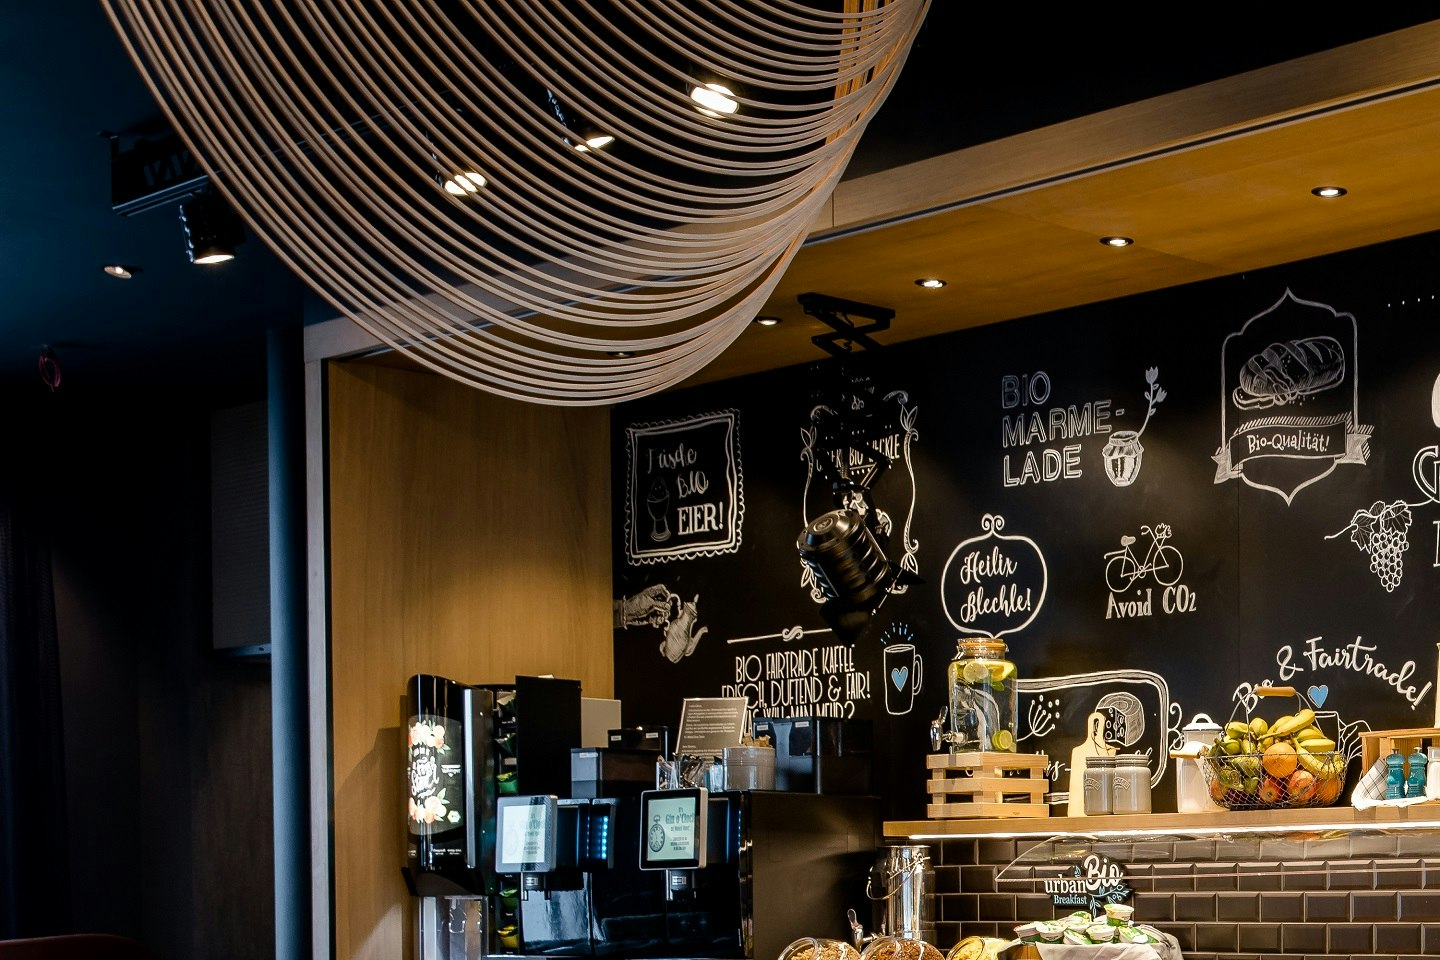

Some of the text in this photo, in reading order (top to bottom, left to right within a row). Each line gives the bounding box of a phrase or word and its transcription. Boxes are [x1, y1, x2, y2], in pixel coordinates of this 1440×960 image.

[1001, 370, 1052, 409] BIO
[1002, 399, 1126, 449] MARME-
[1247, 429, 1330, 453] Bio-Qualität!
[1003, 444, 1083, 488] LADE
[677, 501, 724, 536] EIER!
[960, 546, 1018, 585] Heilix
[960, 586, 1032, 623] Blechle!
[1106, 588, 1152, 619] Avoid
[735, 654, 762, 682] BIO
[766, 648, 819, 680] FAIRTRADE
[1277, 645, 1304, 681] &
[1303, 635, 1433, 711] Fairtrade!
[770, 676, 823, 707] DUFTEND
[827, 675, 841, 702] &
[846, 670, 871, 700] FAIR!
[1045, 854, 1124, 894] urban Bio
[1053, 894, 1088, 905] Breakfast
